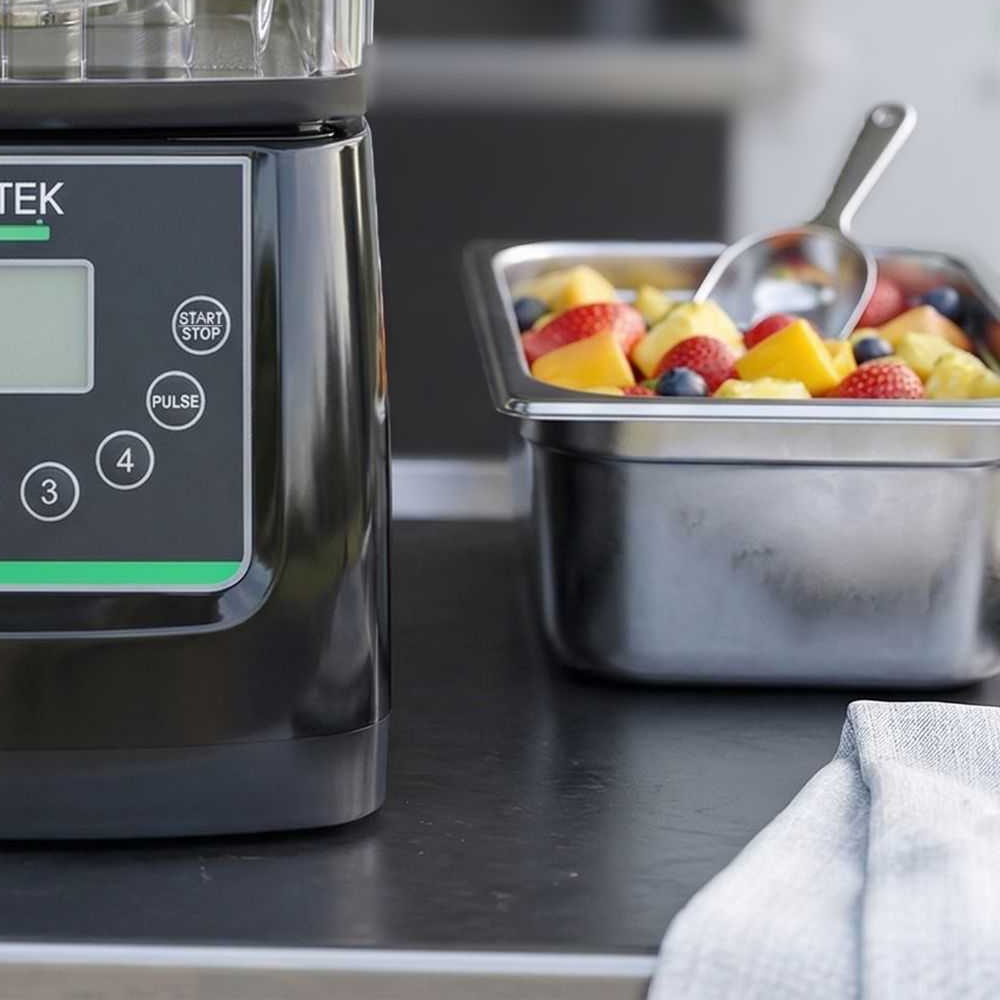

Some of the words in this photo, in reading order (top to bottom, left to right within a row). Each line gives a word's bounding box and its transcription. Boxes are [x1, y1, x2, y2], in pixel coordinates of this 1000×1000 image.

[179, 312, 223, 325] START
[182, 327, 221, 340] STOP
[152, 395, 199, 408] PULSE
[116, 448, 134, 473] 4
[41, 479, 58, 505] 3
